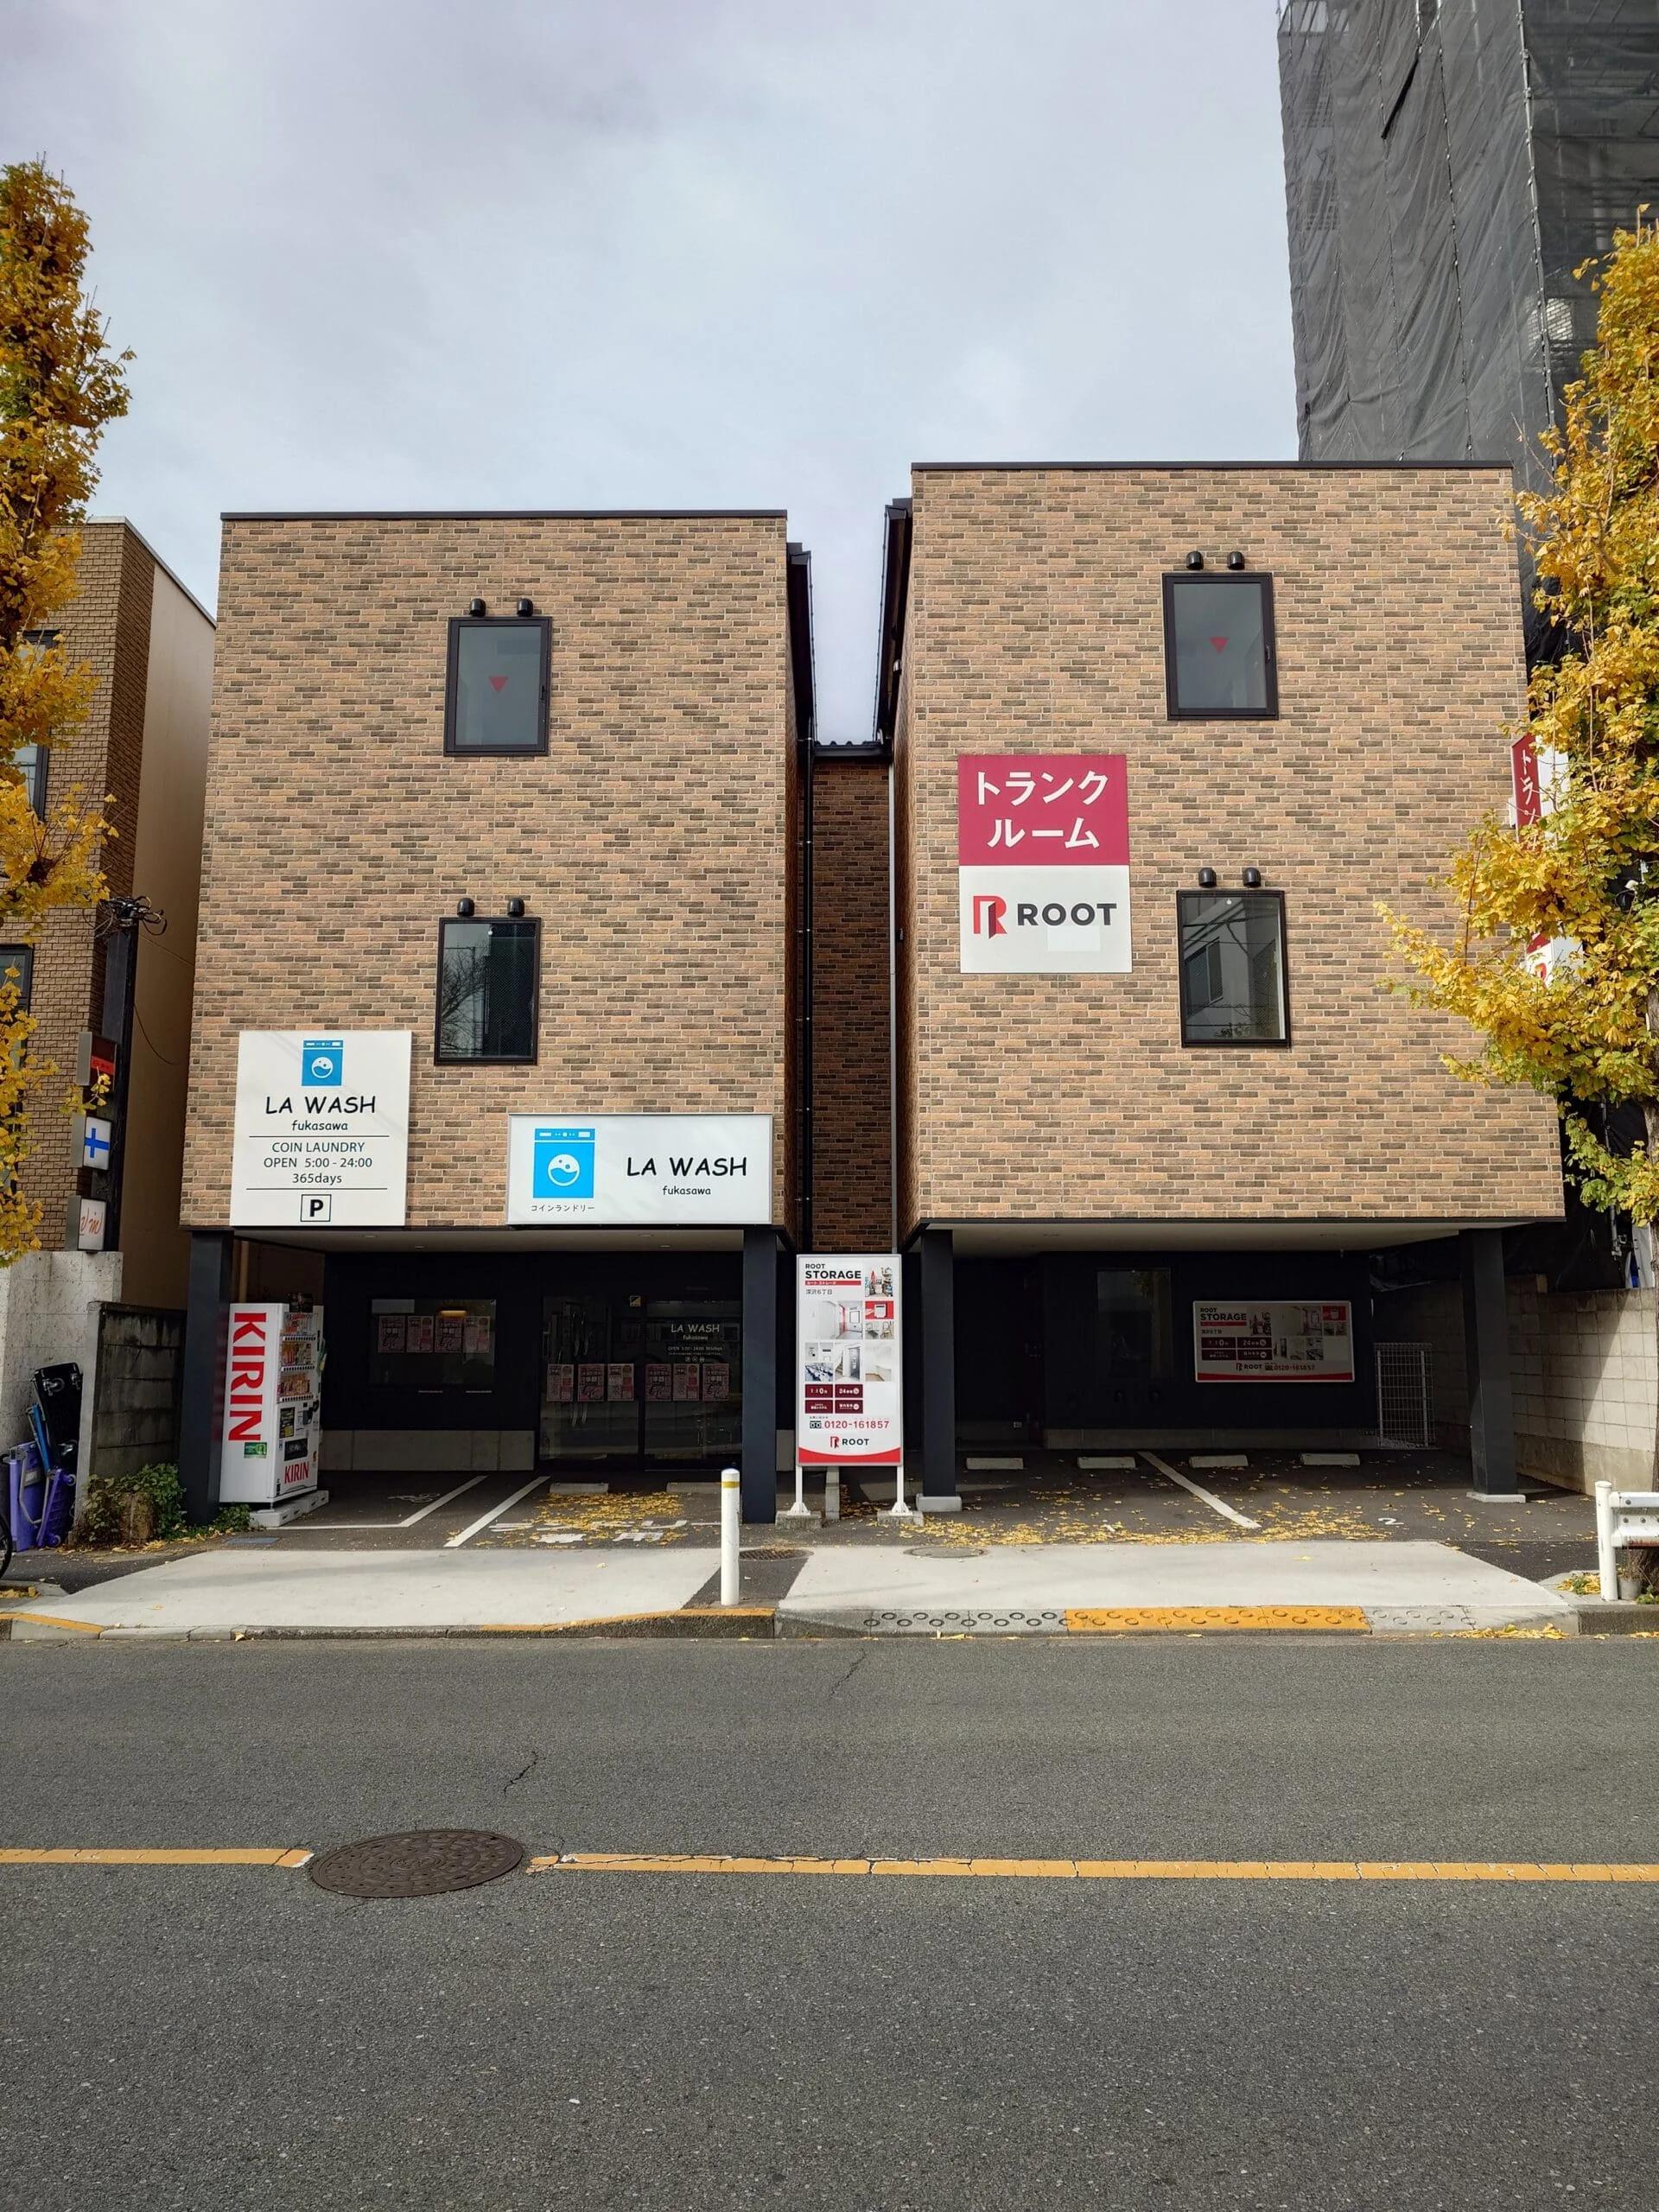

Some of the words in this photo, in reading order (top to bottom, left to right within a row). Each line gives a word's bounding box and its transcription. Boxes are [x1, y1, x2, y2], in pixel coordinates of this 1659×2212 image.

[977, 770, 1109, 806] トランク
[987, 817, 1100, 849] ルーム
[1017, 903, 1117, 926] ROOT
[265, 1096, 293, 1114] LA
[304, 1096, 376, 1114] WASH
[291, 1120, 348, 1131] fukasawa
[271, 1142, 302, 1153] COIN
[306, 1142, 365, 1153] LAUNDRY
[264, 1157, 297, 1168] OPEN
[304, 1158, 330, 1168] 5:00
[340, 1157, 372, 1168] 24:00
[626, 1156, 657, 1177] LA
[669, 1156, 747, 1177] WASH
[292, 1173, 342, 1185] 365days
[662, 1185, 711, 1195] fukasawa
[309, 1199, 324, 1217] P
[531, 1204, 594, 1212] コインランドリー
[805, 1270, 861, 1279] STORAGE
[671, 1324, 683, 1333] LA
[687, 1324, 720, 1333] WASH
[227, 1312, 267, 1441] KIRIN
[284, 1461, 309, 1484] KIRIN
